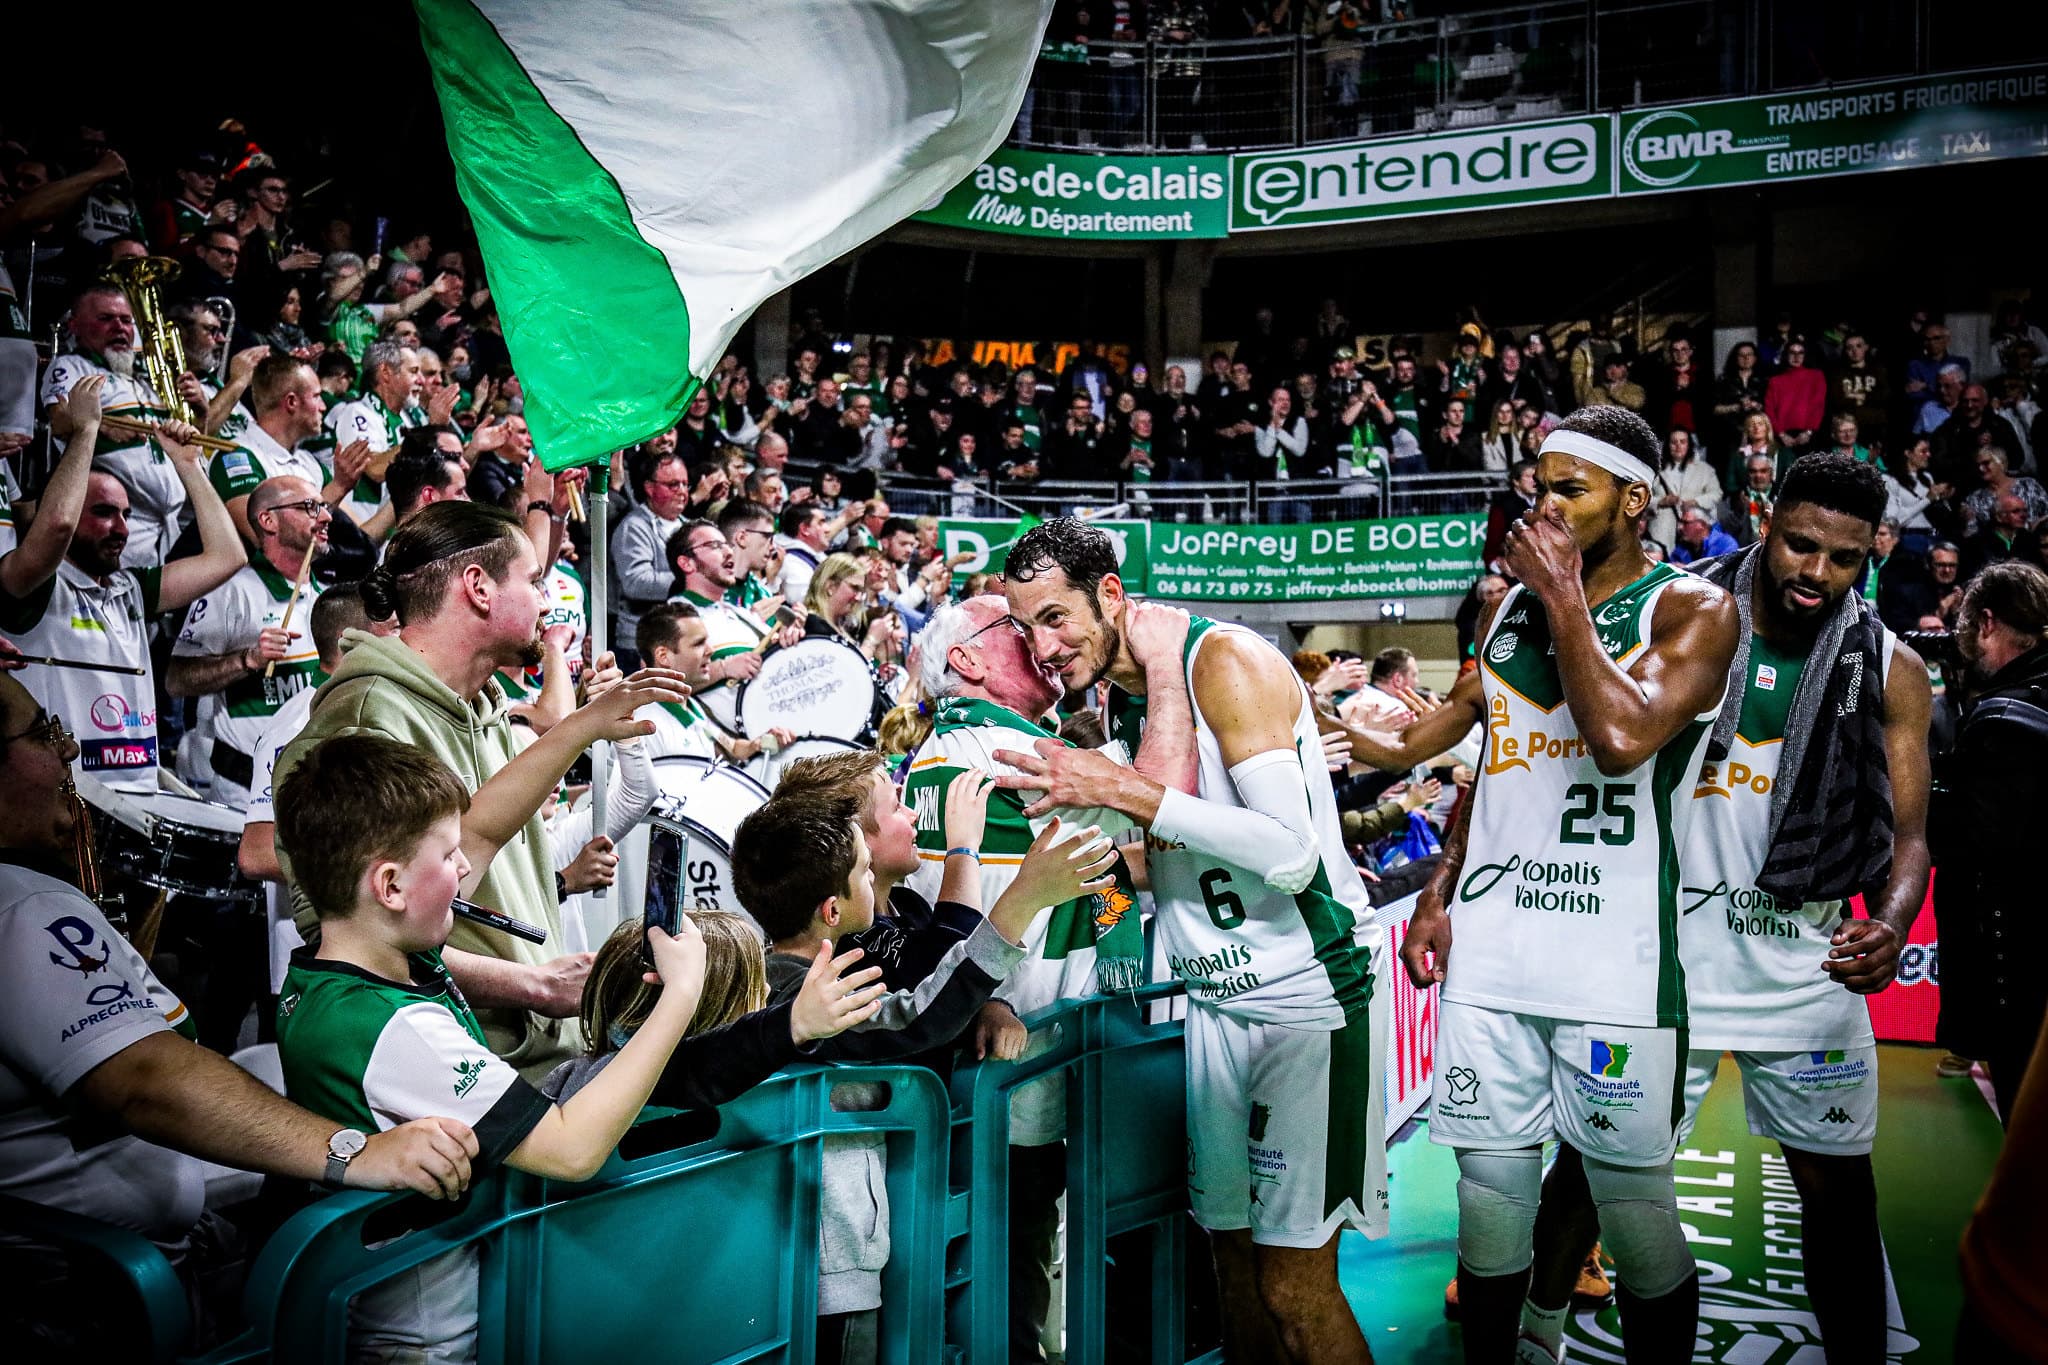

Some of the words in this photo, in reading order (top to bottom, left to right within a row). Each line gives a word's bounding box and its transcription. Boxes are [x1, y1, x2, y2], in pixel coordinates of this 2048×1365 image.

[1766, 92, 1896, 126] TRANSPORTS
[1639, 129, 1733, 163] BMR
[1738, 135, 1790, 146] TRANSPORTS
[1766, 138, 1921, 174] ENTREPOSAGE
[1941, 129, 1991, 156] TAXI
[1256, 136, 1589, 204] entendre
[968, 193, 1026, 226] Mon
[1030, 208, 1193, 235] Département
[1161, 529, 1298, 563] Joffrey
[1311, 527, 1356, 555] DE
[1368, 520, 1489, 552] BOECK
[1157, 580, 1178, 594] 06
[1181, 580, 1202, 595] 84
[1206, 581, 1226, 596] 73
[1230, 582, 1250, 596] 89
[1254, 582, 1273, 596] 75
[103, 749, 149, 765] Max
[1559, 783, 1636, 846] 25
[1522, 859, 1601, 887] Copalis
[1199, 867, 1247, 930] 6
[1516, 885, 1601, 914] Valofish
[1726, 909, 1800, 939] Valofish
[453, 1059, 487, 1097] Airspire
